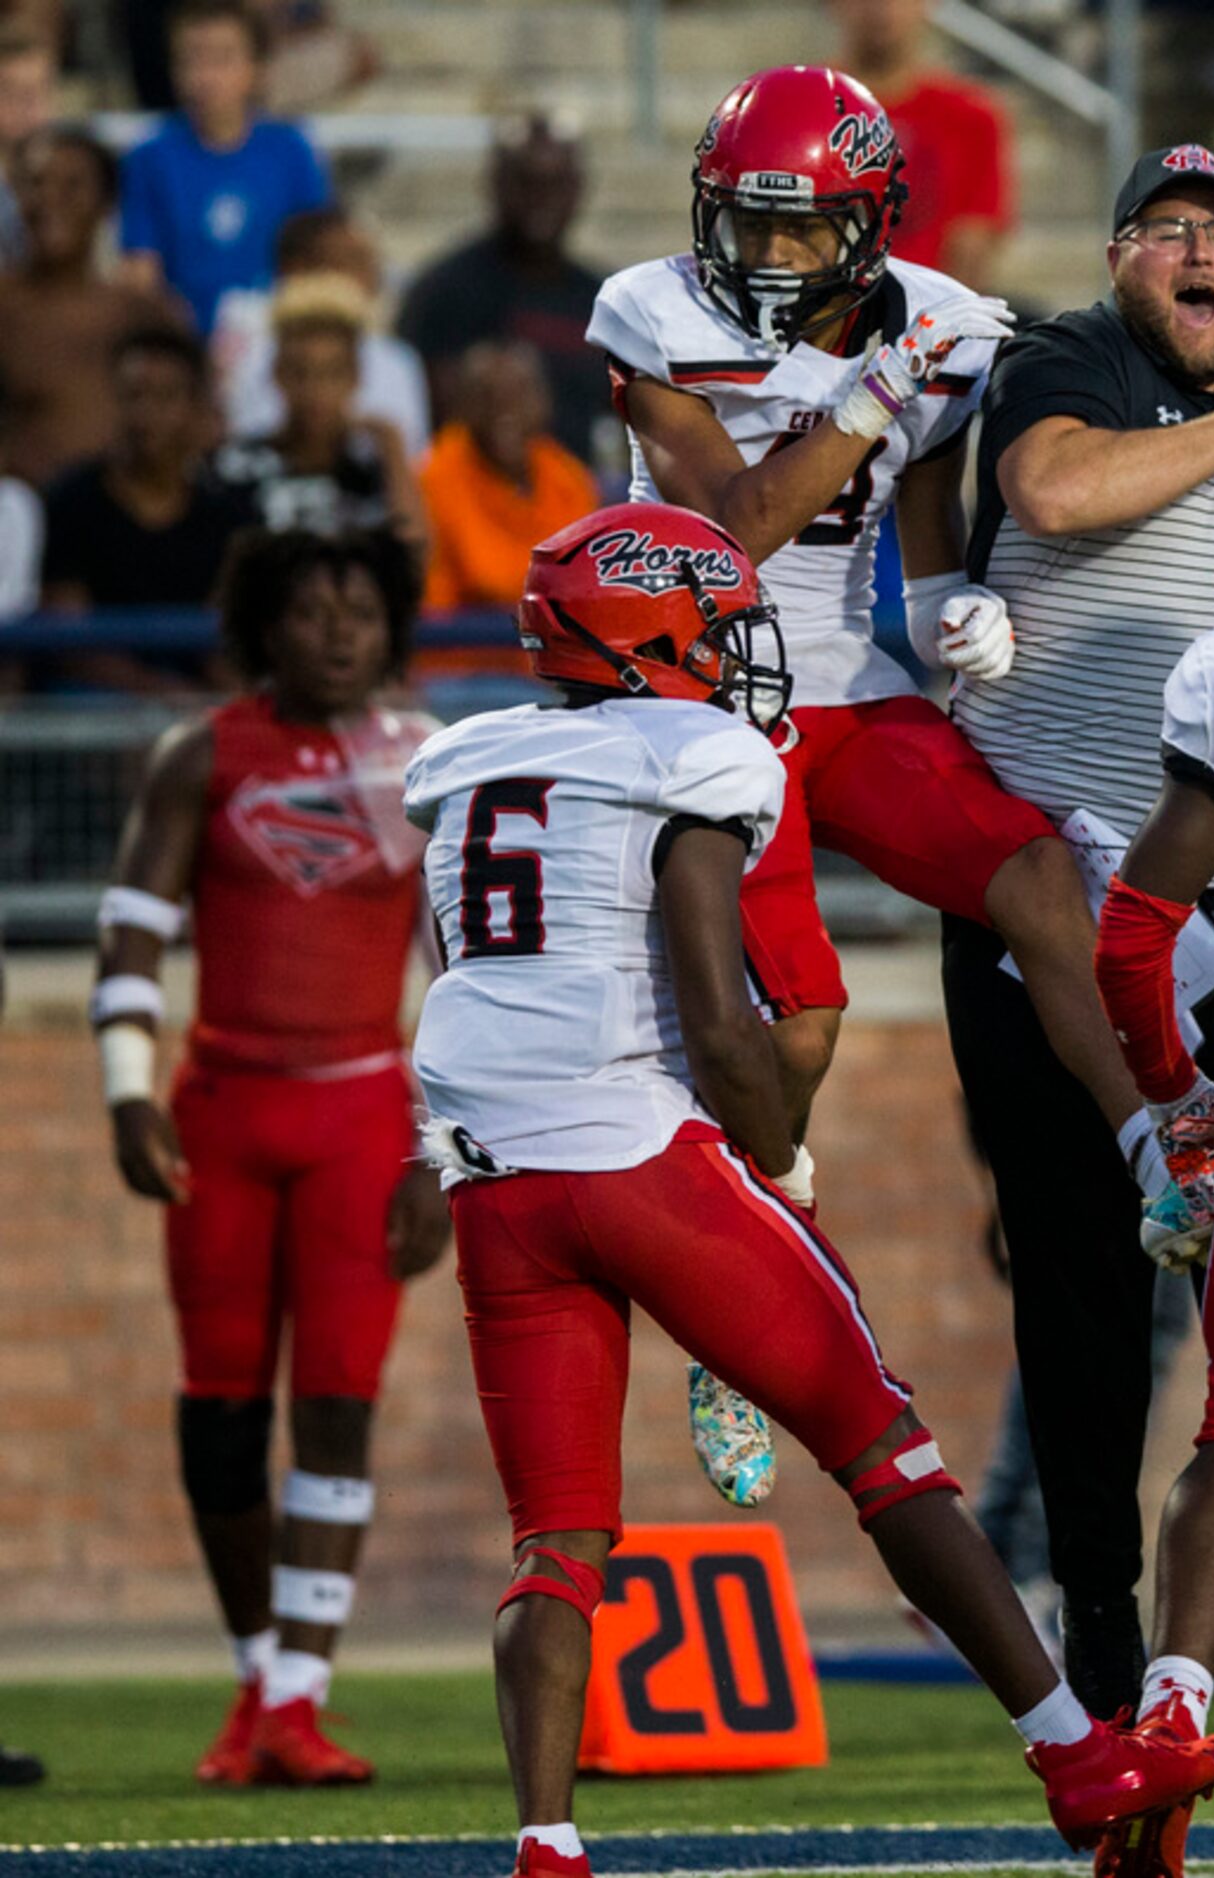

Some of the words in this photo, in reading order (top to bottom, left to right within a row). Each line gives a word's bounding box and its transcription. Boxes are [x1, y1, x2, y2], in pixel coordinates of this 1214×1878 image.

[588, 528, 743, 582] Horns
[460, 778, 557, 960] 6
[602, 1553, 797, 1735] 20
